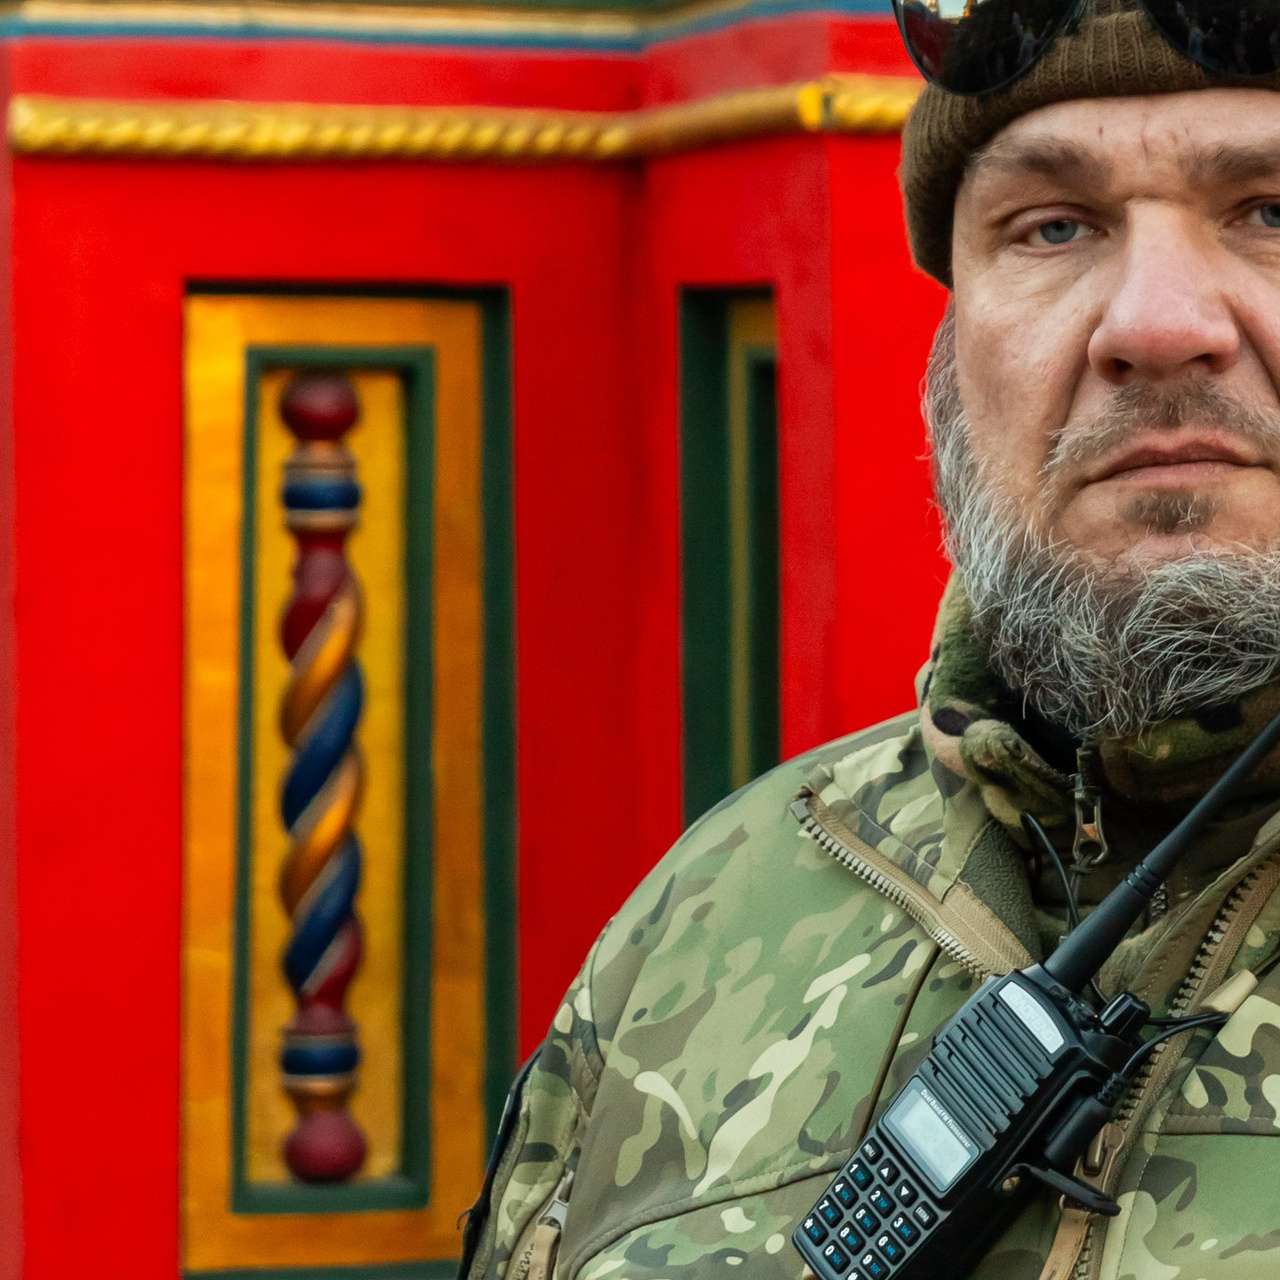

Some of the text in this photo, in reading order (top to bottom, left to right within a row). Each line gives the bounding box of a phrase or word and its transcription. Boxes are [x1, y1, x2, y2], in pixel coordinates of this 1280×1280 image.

[849, 1163, 859, 1173] 1
[834, 1183, 844, 1193] 4
[870, 1190, 881, 1202] 2
[818, 1200, 830, 1210] 7
[855, 1208, 866, 1219] 5
[893, 1217, 904, 1228] 3
[840, 1227, 850, 1238] 8
[878, 1235, 889, 1246] 6
[825, 1245, 835, 1256] 0
[862, 1254, 873, 1265] 9
